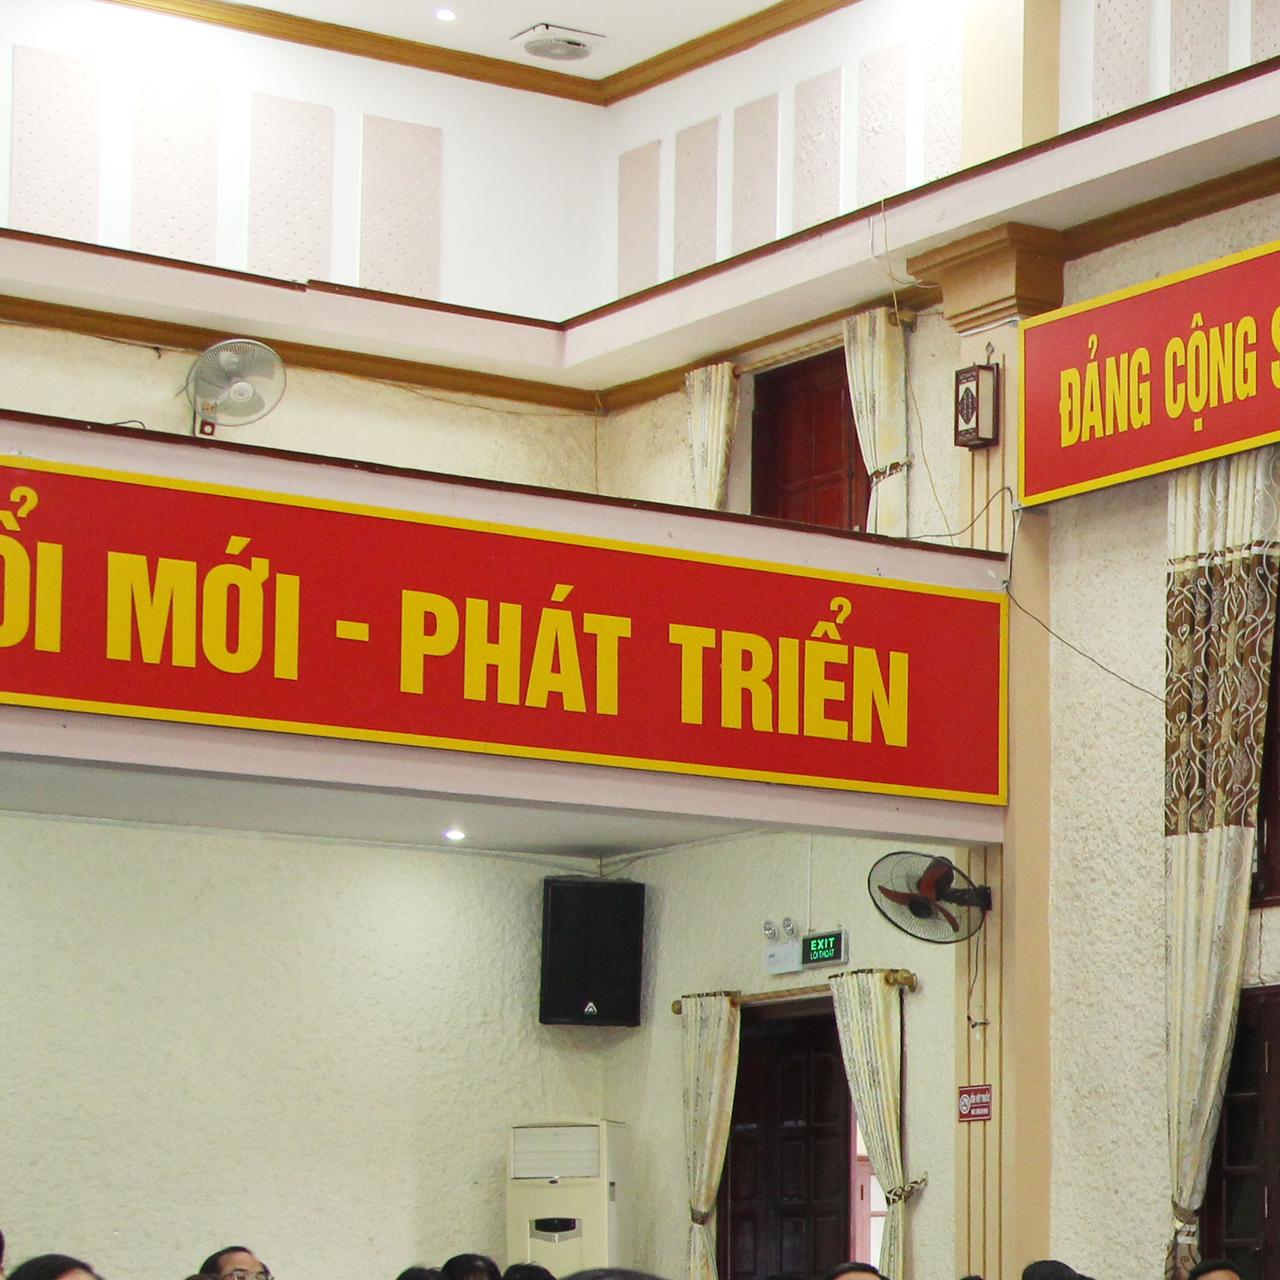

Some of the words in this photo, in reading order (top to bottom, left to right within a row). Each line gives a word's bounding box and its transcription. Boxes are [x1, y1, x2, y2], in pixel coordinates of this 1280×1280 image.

[1060, 336, 1150, 448] ĐẢNG
[1164, 314, 1256, 431] CỘNG
[106, 535, 300, 681] MỚI
[400, 584, 631, 717] PHÁT
[667, 596, 909, 748] TRIỂN
[810, 937, 836, 951] EXIT
